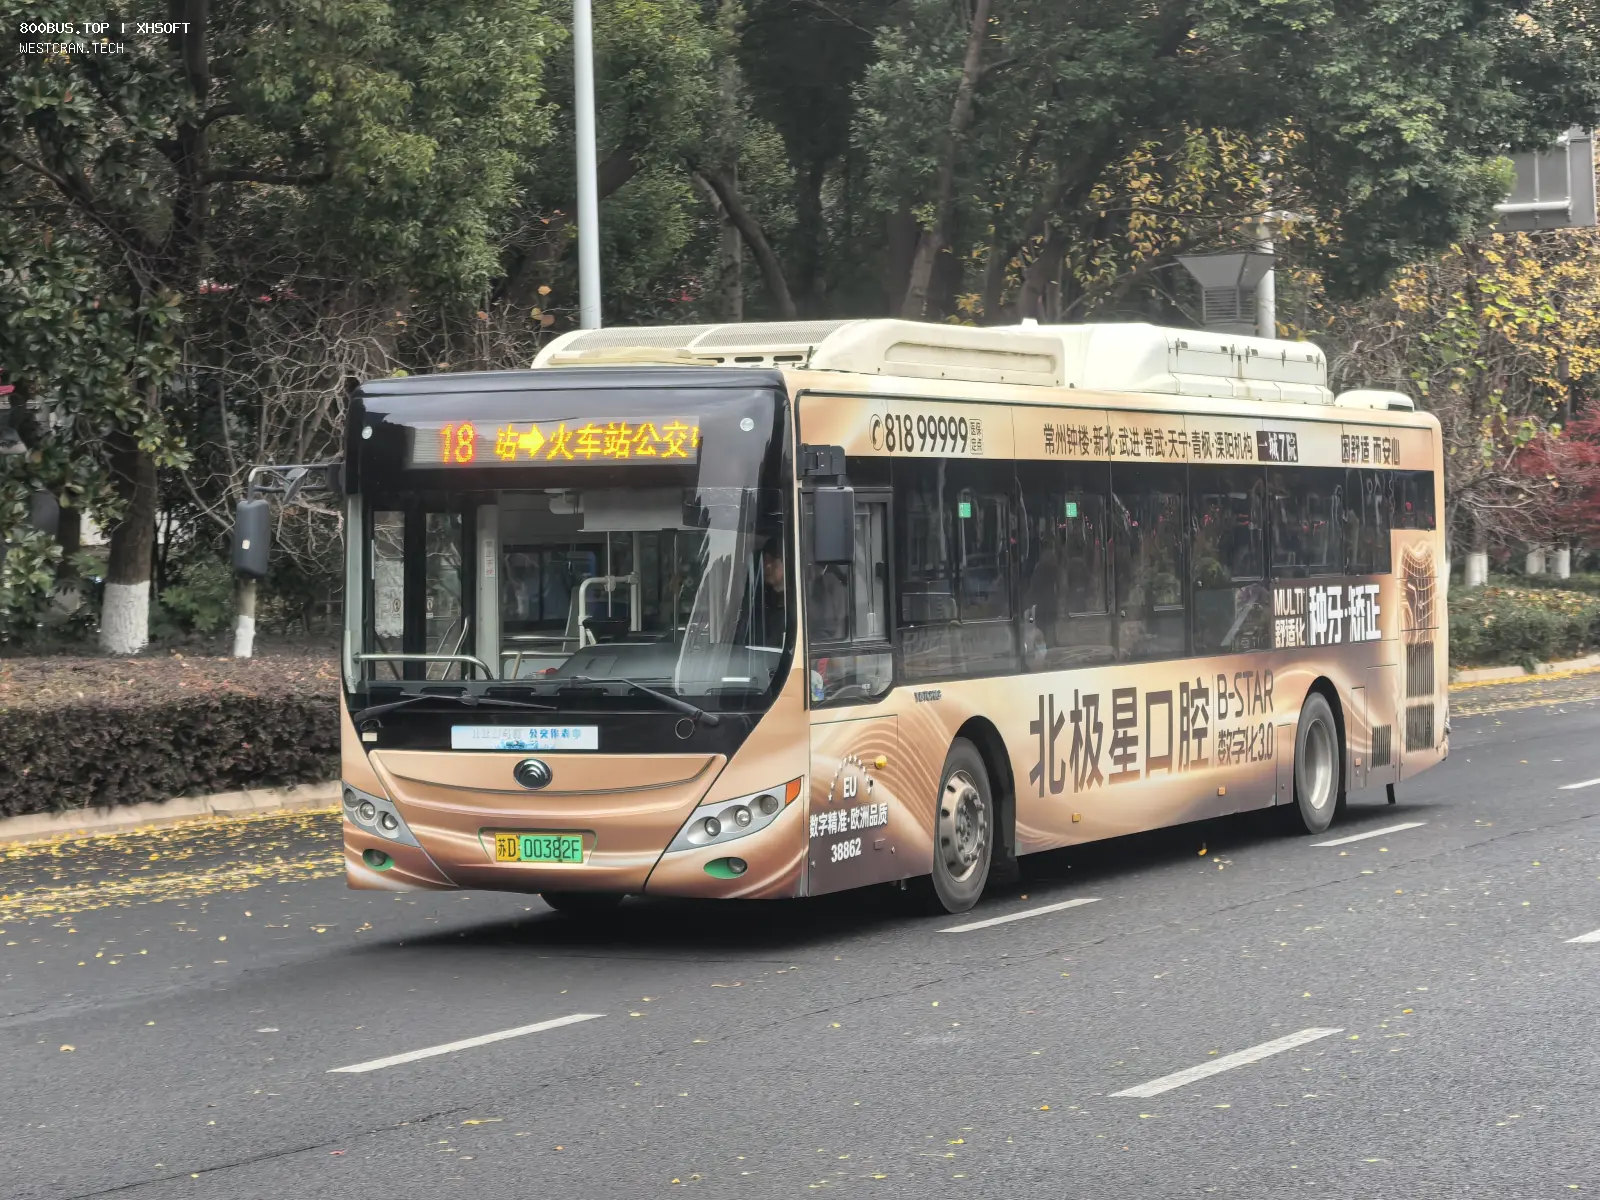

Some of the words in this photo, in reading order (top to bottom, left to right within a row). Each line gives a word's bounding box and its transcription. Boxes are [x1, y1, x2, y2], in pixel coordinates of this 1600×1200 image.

[440, 423, 474, 463] 18
[546, 421, 699, 460] 火车站公交
[1274, 617, 1306, 649] 舒适化
[1216, 669, 1274, 721] B-STAR
[1029, 677, 1210, 799] 北极星口腔
[1216, 722, 1274, 768] 数字化3.0
[843, 776, 857, 798] EU
[523, 838, 580, 859] 00382F
[831, 837, 862, 863] 38862
